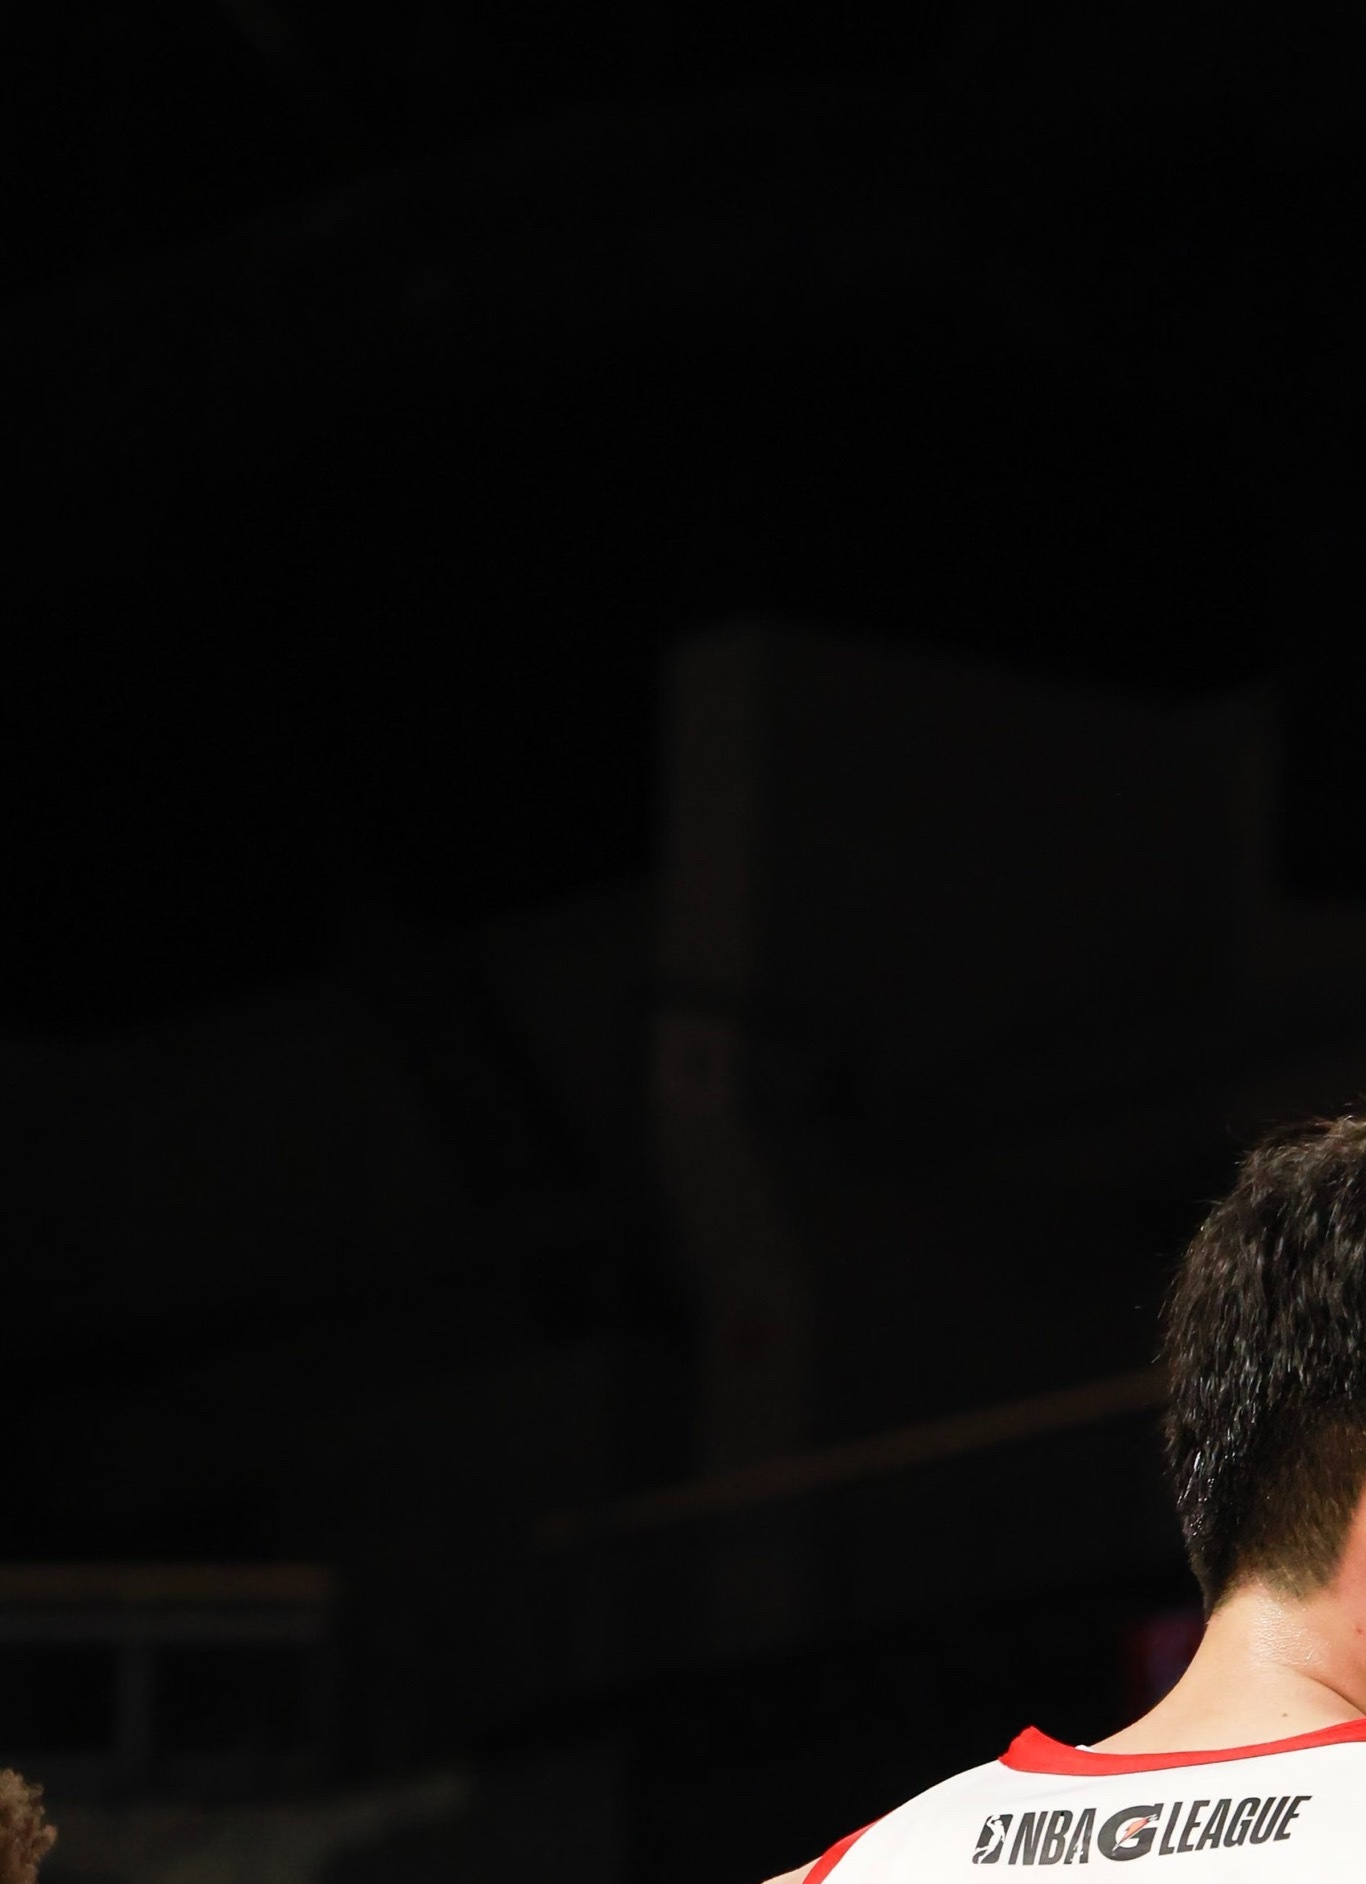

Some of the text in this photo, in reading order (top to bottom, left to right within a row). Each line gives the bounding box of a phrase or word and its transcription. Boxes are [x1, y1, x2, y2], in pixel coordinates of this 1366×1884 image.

[1008, 1795, 1313, 1866] NBA G LEAGUE
